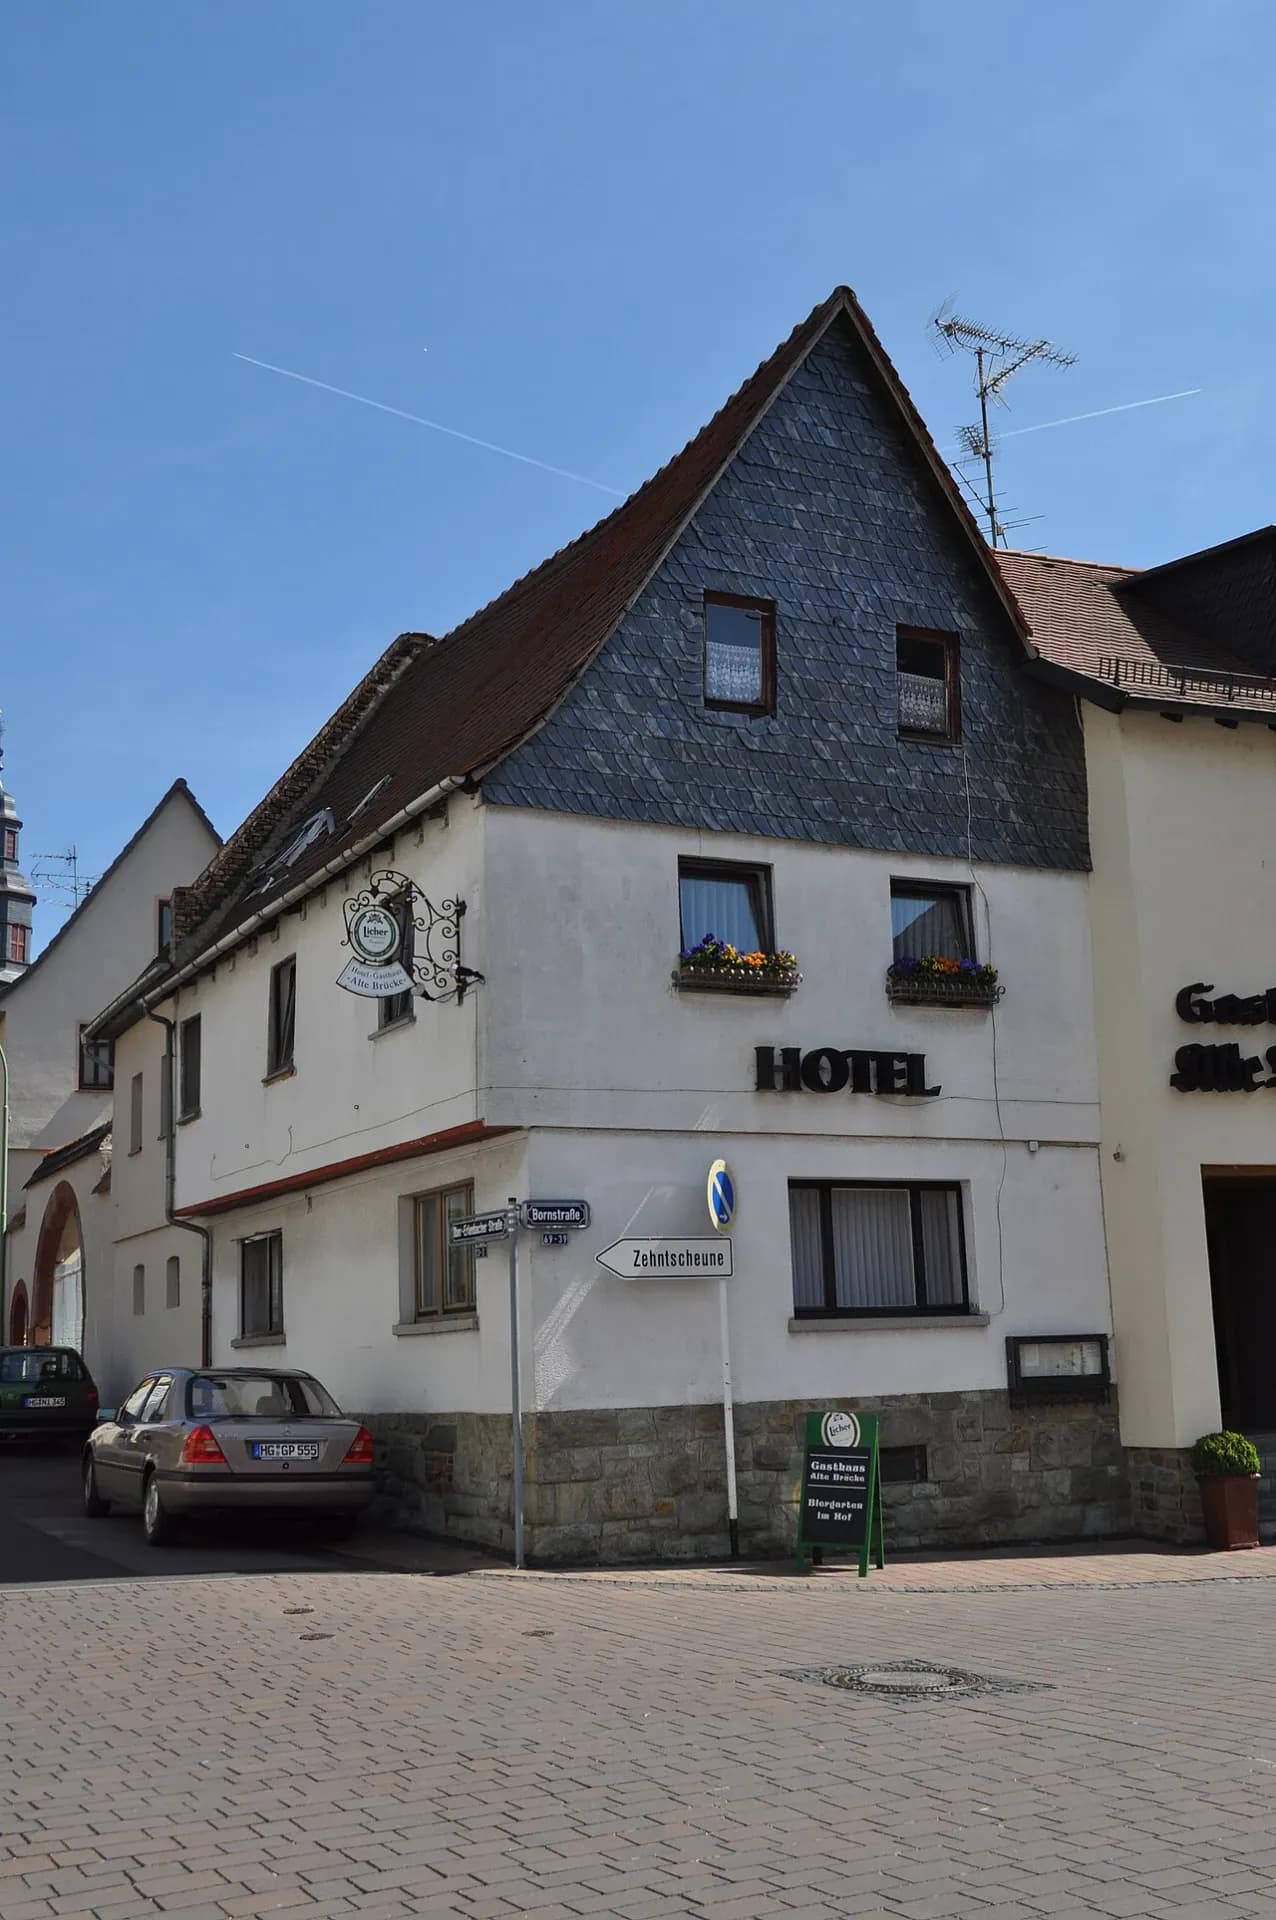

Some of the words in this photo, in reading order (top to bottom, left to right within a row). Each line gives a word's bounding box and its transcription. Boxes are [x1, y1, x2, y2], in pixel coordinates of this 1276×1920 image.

[364, 926, 389, 938] Licher
[754, 1046, 942, 1096] HOTEL
[532, 1208, 581, 1221] Bornstraße
[633, 1249, 724, 1268] Zehntscheune
[829, 1424, 852, 1437] Licher
[260, 1444, 275, 1457] HG
[281, 1444, 295, 1456] GP
[297, 1444, 317, 1456] 555
[811, 1461, 866, 1472] Gasthaus
[808, 1498, 863, 1510] Biergarten
[834, 1512, 852, 1521] Hof
